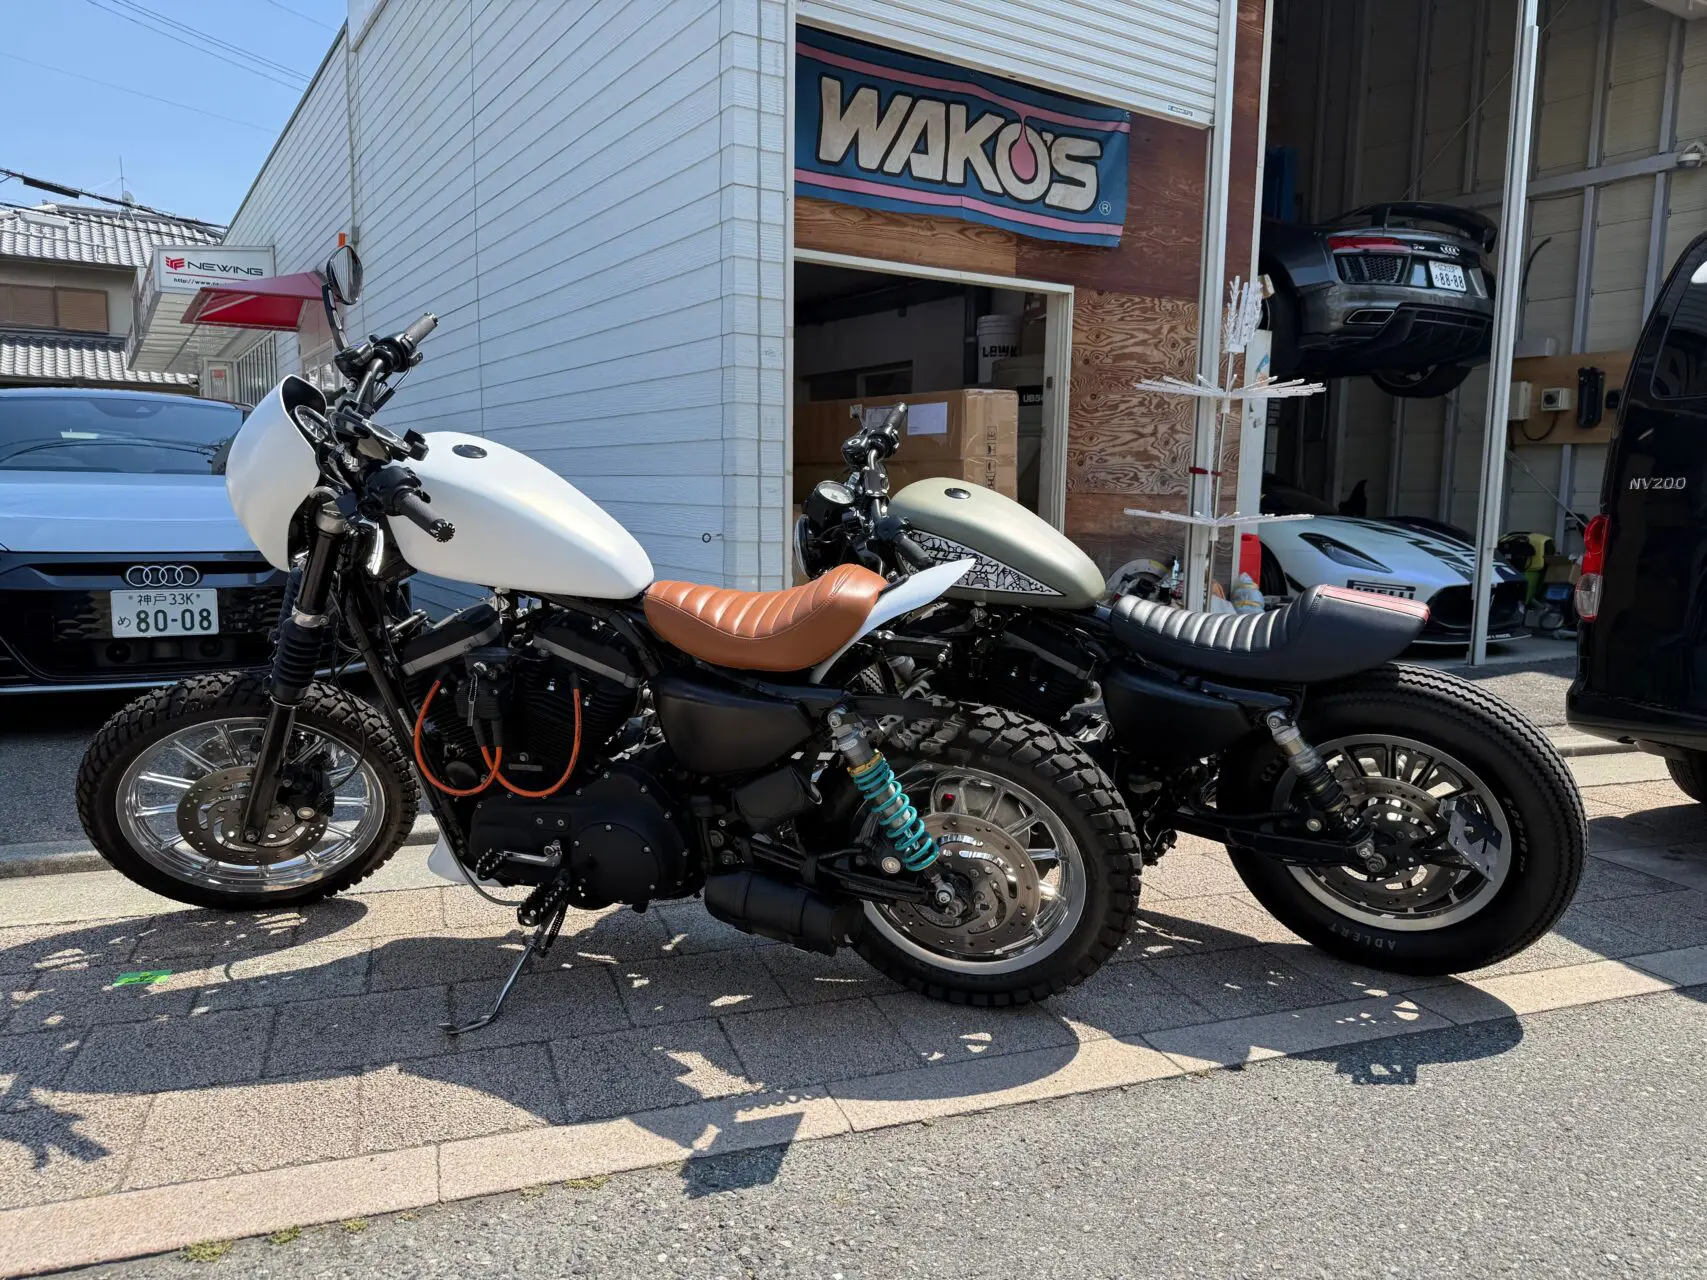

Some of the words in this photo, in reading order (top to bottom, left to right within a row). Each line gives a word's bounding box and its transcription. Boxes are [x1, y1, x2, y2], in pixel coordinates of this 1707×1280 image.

[817, 74, 1104, 213] WAKO'S
[187, 261, 263, 276] NEWING
[1629, 476, 1687, 490] NV200
[117, 616, 132, 628] め
[136, 608, 212, 633] 80-08
[1328, 923, 1397, 951] ADLERT
